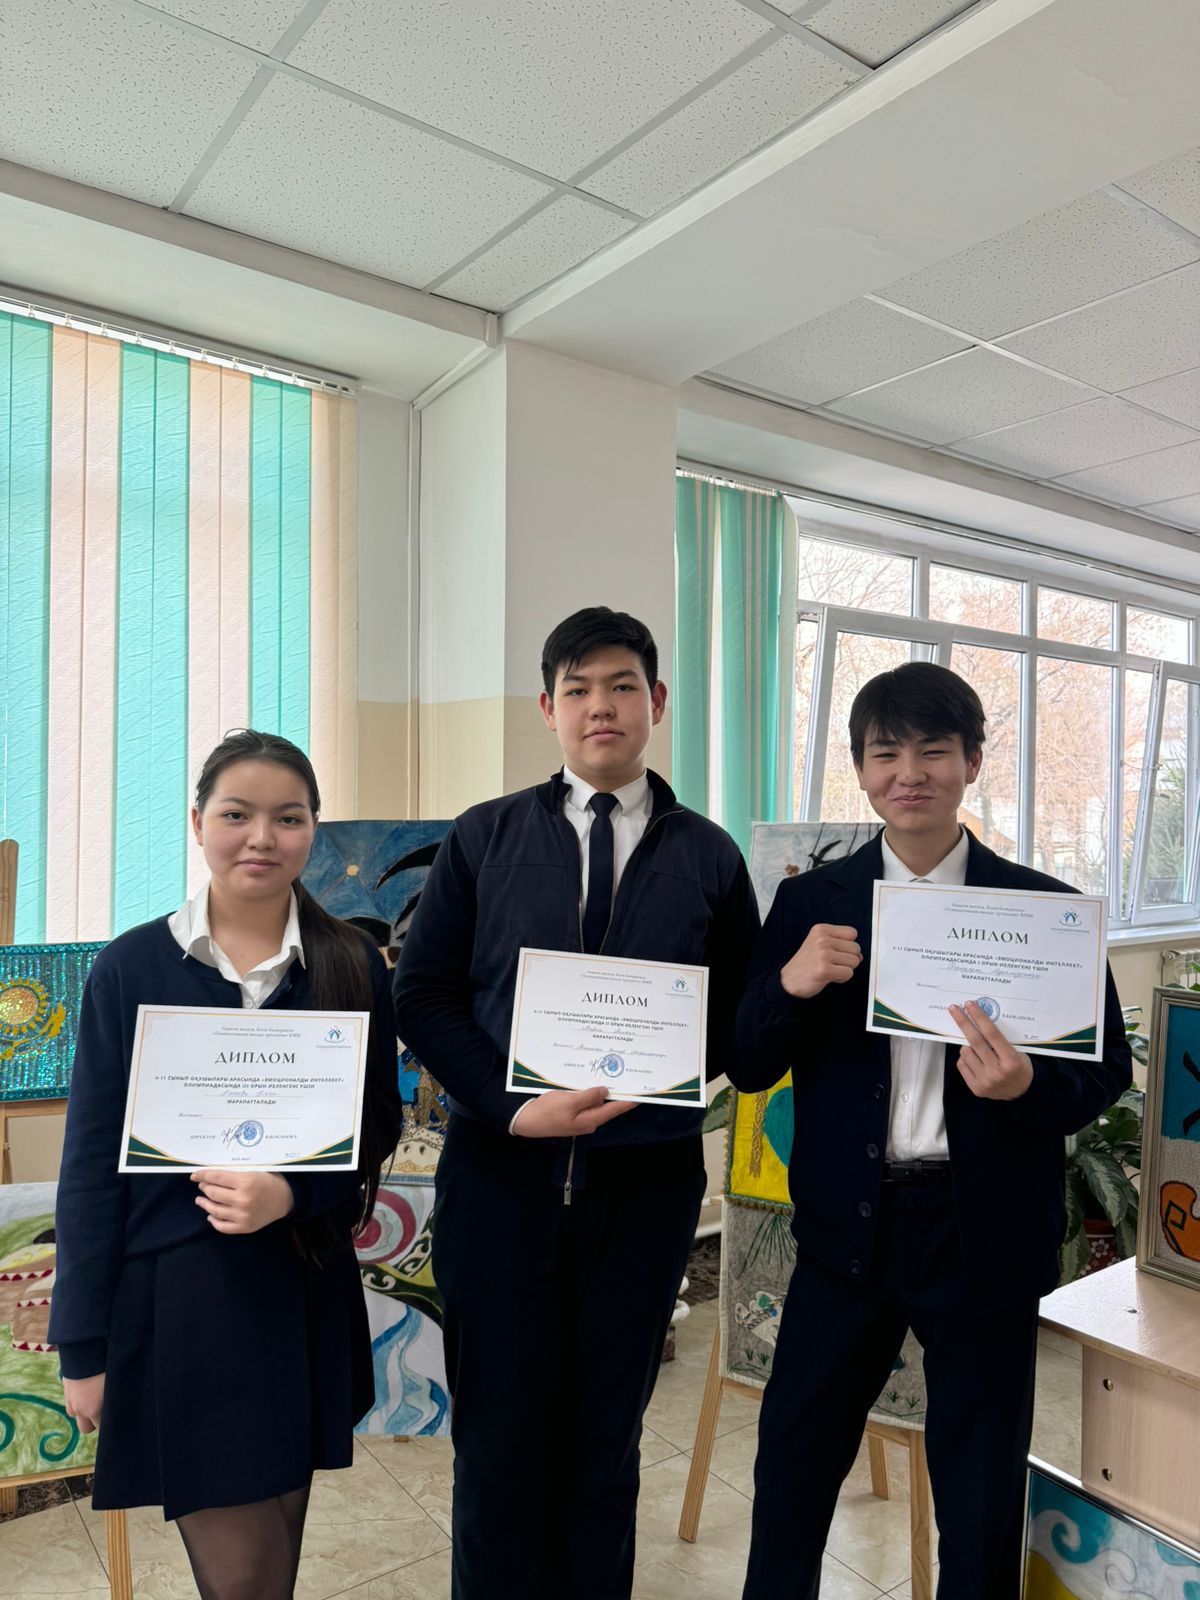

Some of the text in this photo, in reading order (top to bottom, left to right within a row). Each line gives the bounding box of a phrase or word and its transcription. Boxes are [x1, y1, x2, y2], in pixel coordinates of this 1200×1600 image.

[946, 927, 1029, 945] ДИПЛОМ
[581, 991, 648, 1008] ДИПЛОМ
[214, 1051, 296, 1064] ДИПЛОМ
